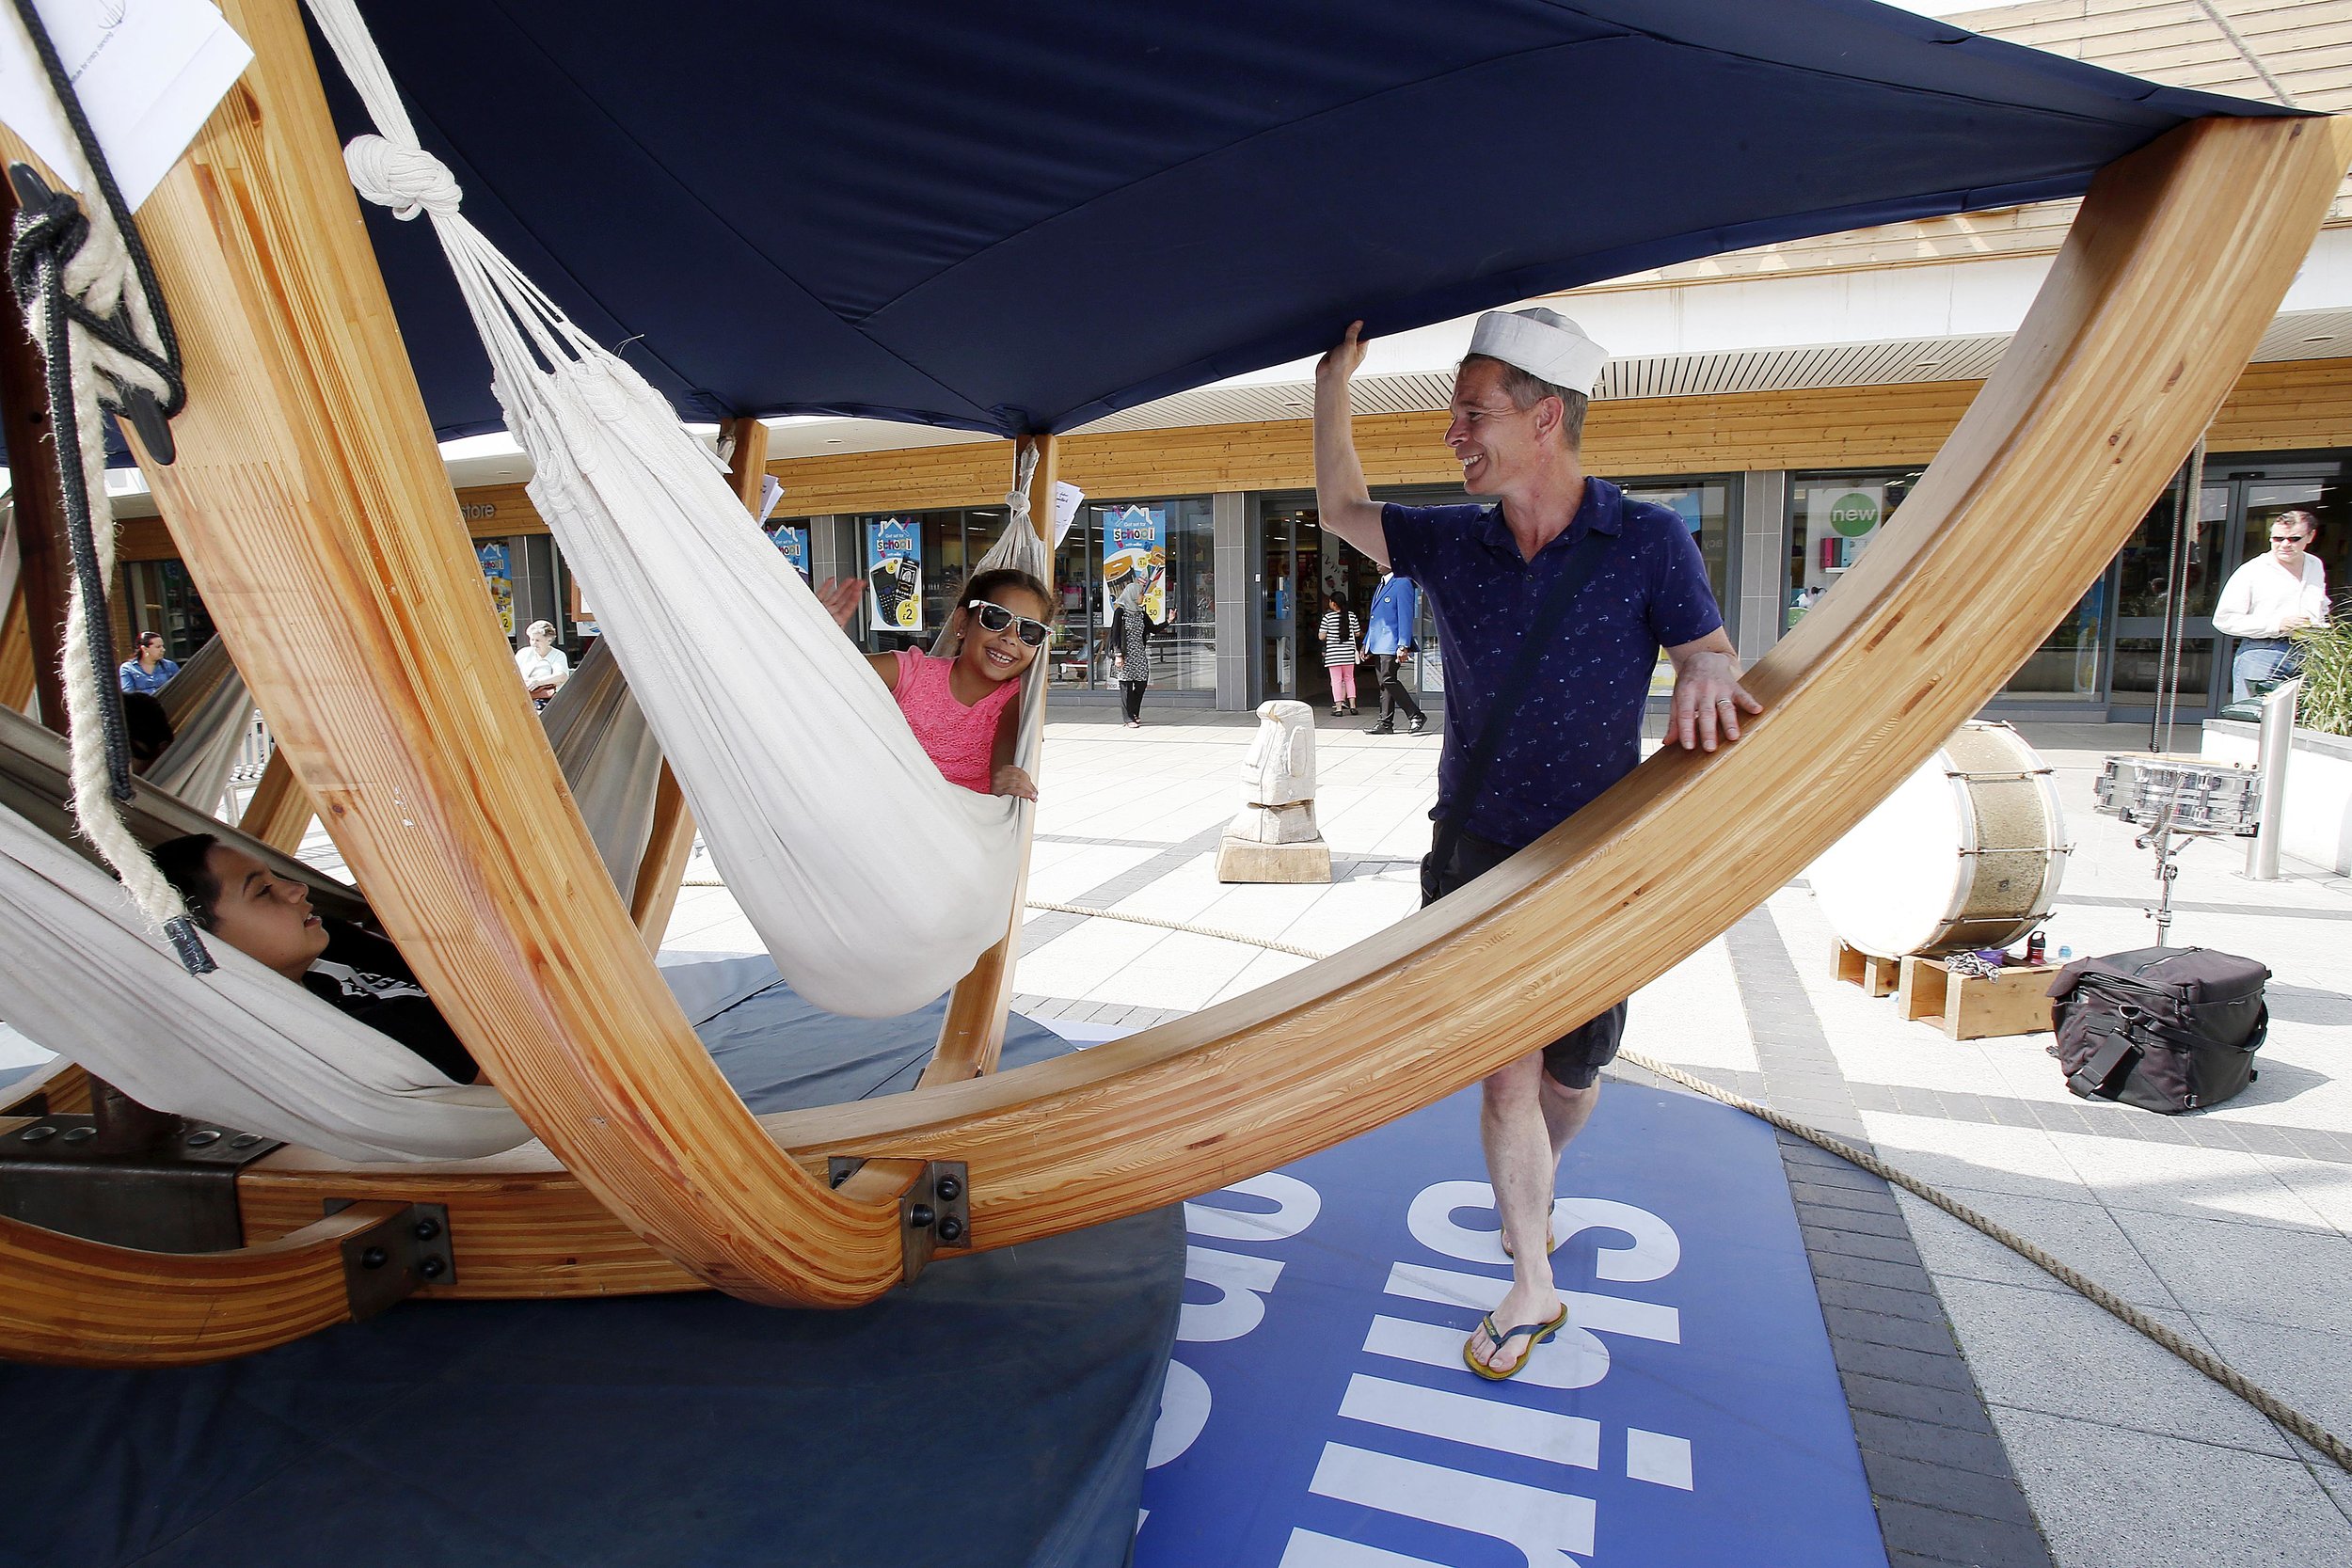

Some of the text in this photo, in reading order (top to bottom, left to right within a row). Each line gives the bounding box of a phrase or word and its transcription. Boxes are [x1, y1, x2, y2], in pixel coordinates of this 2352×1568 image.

[1832, 509, 1876, 521] new
[1115, 528, 1154, 541] school
[878, 539, 912, 551] school
[902, 609, 913, 620] £2
